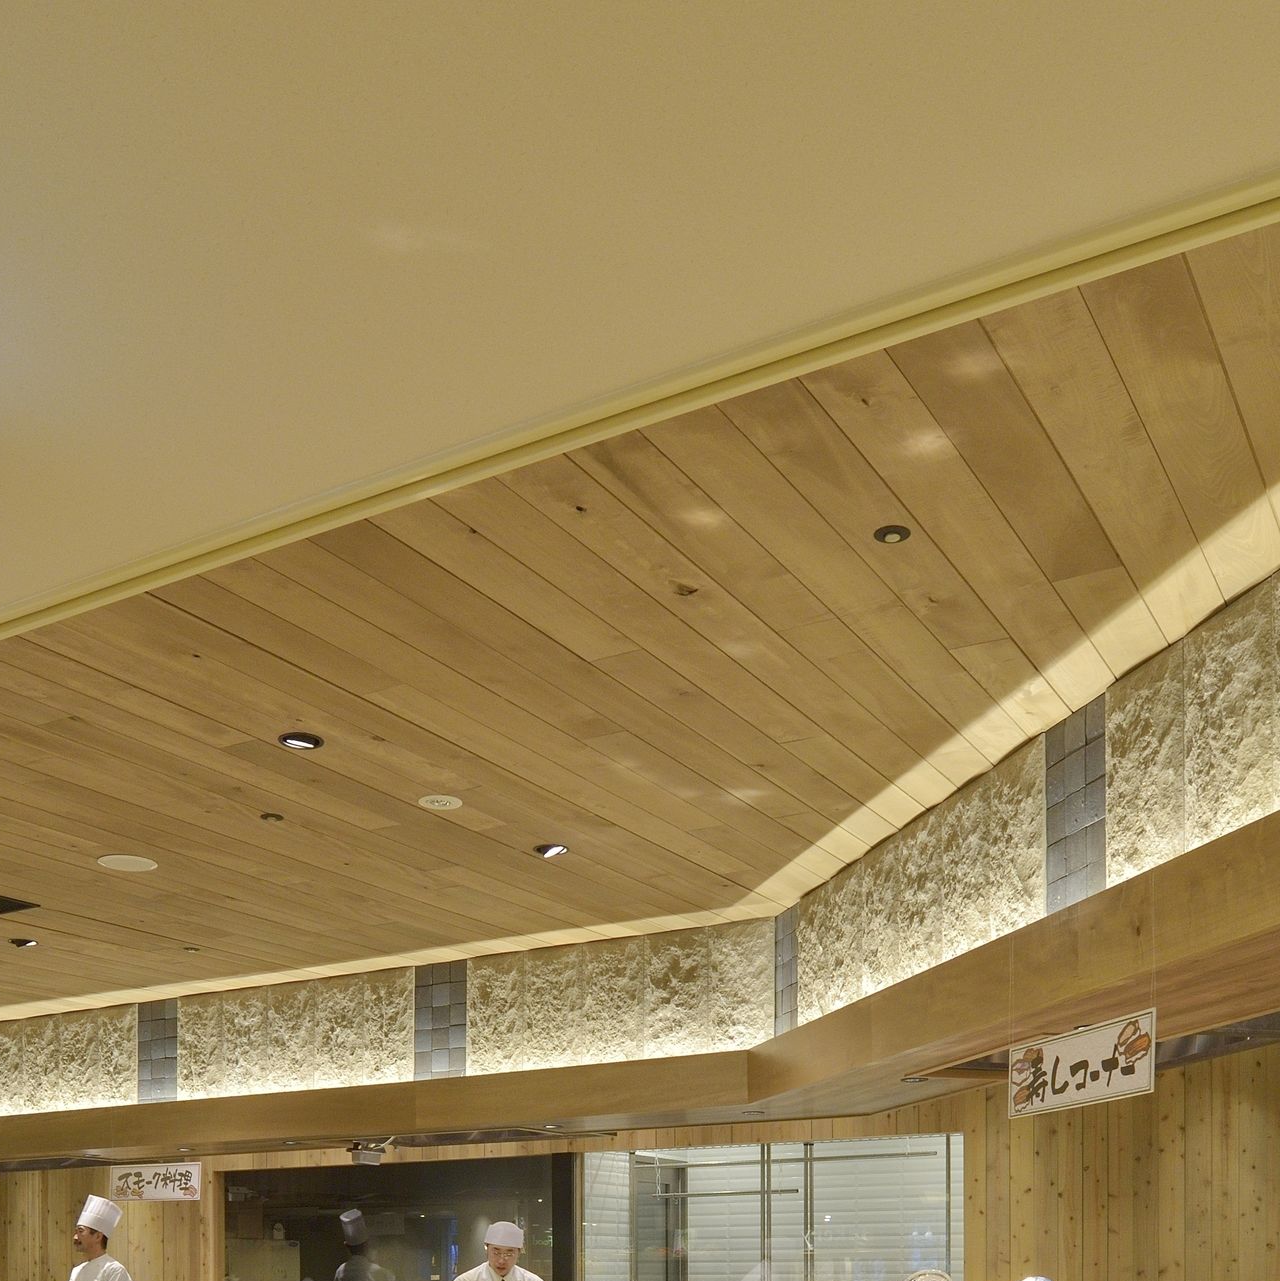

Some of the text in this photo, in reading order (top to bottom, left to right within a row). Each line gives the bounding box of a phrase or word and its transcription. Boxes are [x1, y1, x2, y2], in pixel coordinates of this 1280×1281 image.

[1028, 1044, 1136, 1106] 寿しコーナー
[118, 1168, 193, 1192] スモーク料理
